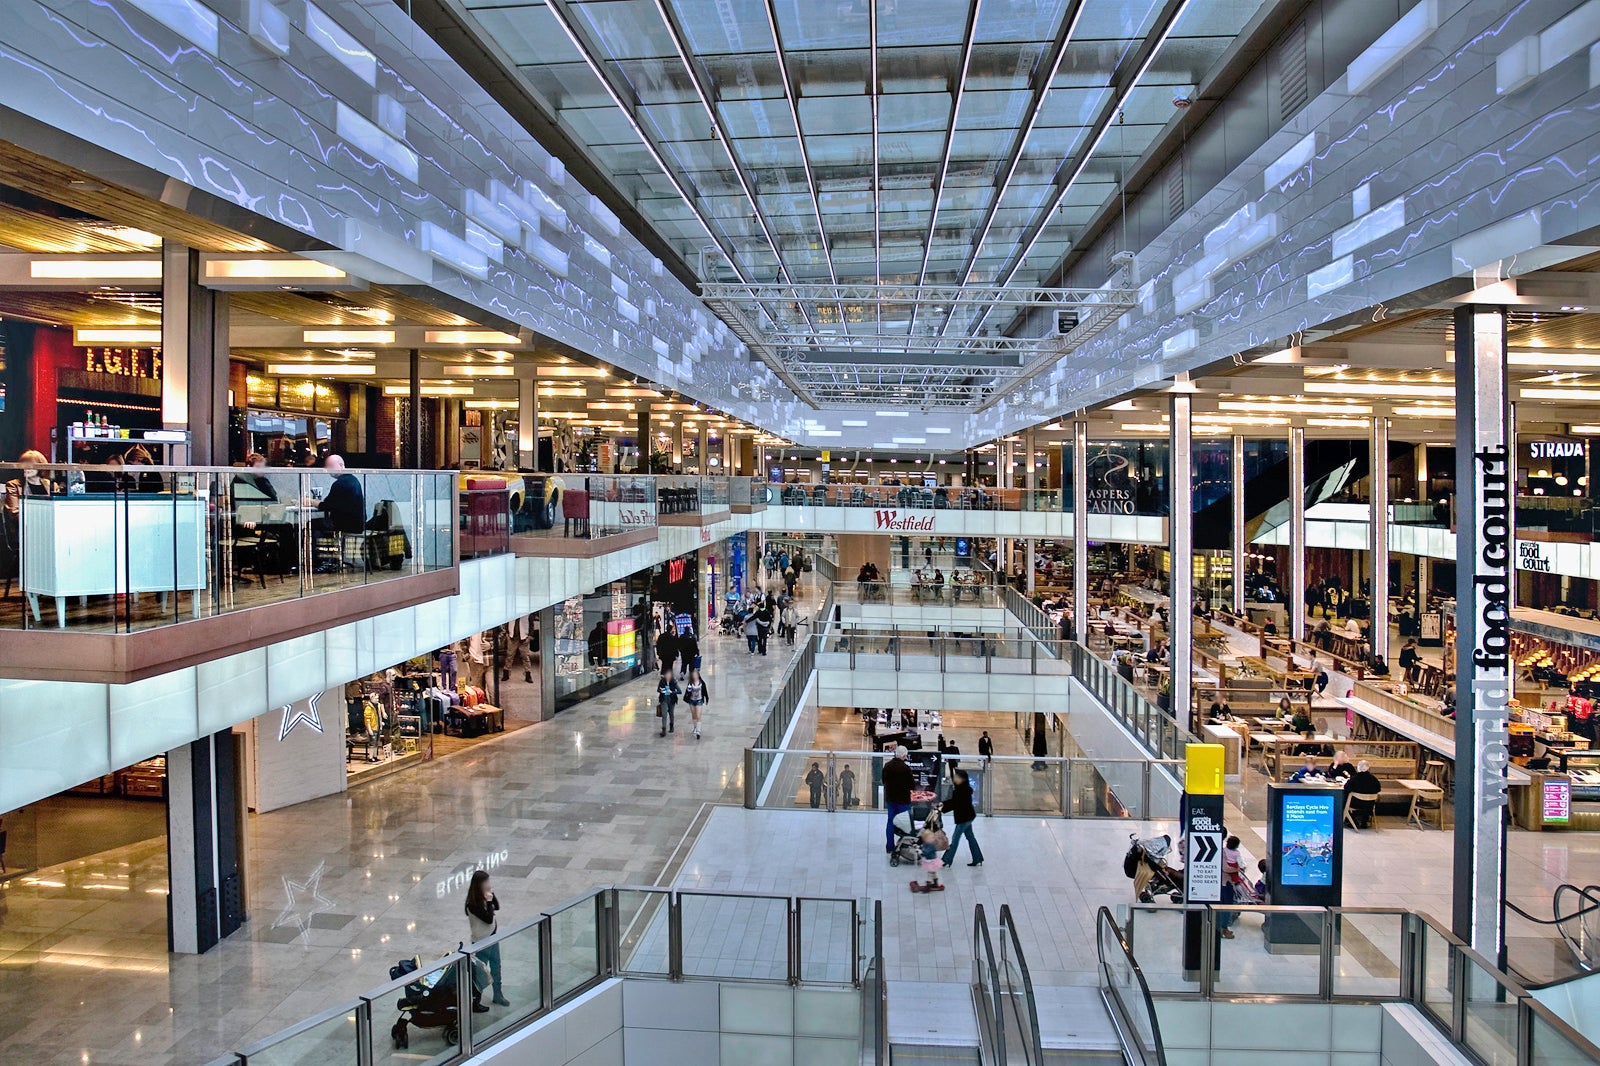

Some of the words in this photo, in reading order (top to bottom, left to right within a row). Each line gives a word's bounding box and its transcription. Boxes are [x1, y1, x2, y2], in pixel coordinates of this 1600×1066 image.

[1530, 442, 1584, 458] STRADA
[1088, 489, 1130, 499] ASPERS
[1474, 444, 1509, 569] court
[874, 509, 935, 531] Westfield
[1519, 542, 1540, 558] food
[1523, 556, 1551, 571] court
[1473, 574, 1510, 676] food
[1472, 677, 1509, 812] world
[1191, 817, 1211, 826] food
[1195, 823, 1221, 831] court
